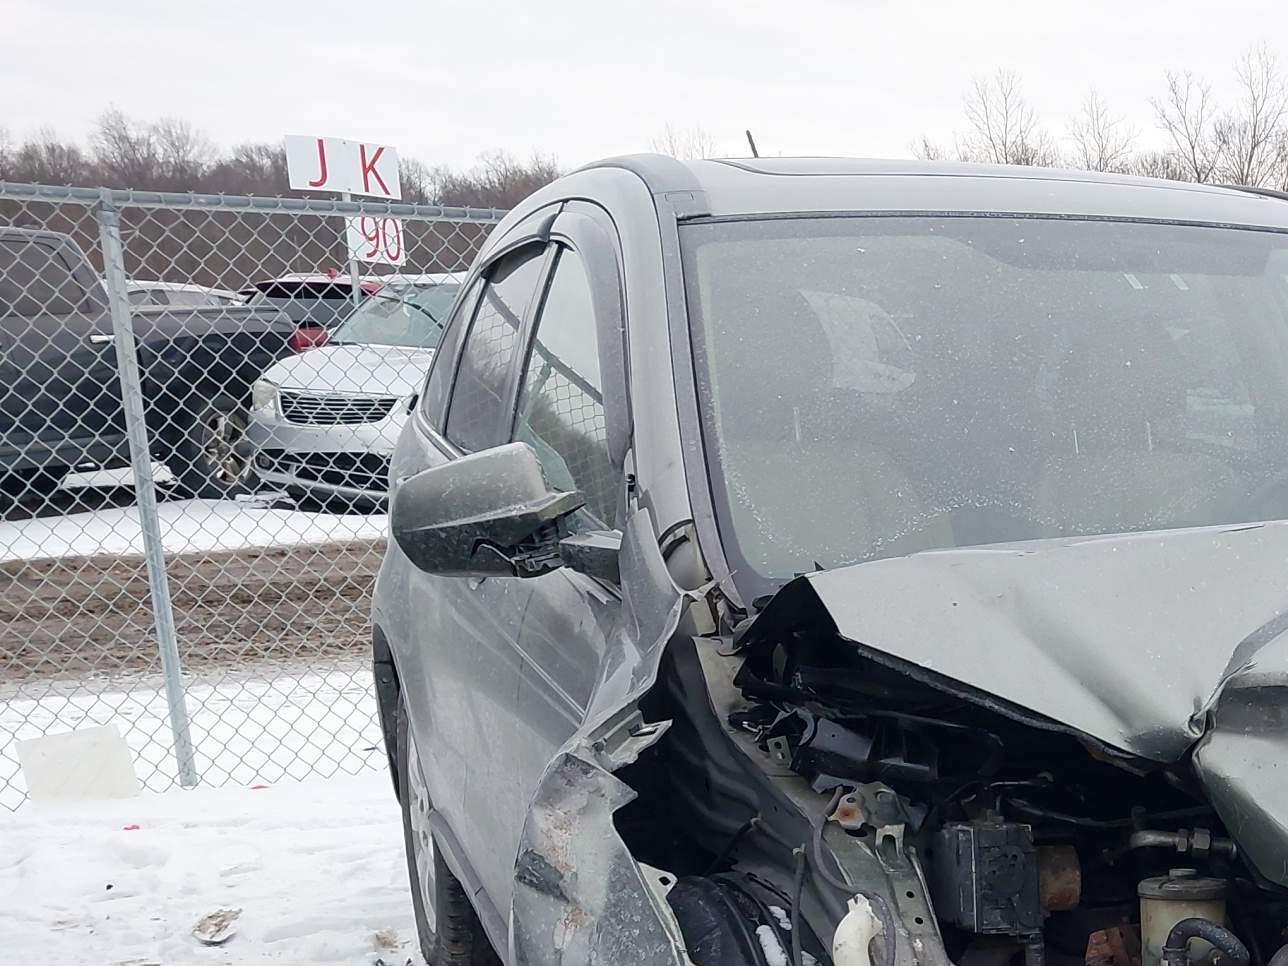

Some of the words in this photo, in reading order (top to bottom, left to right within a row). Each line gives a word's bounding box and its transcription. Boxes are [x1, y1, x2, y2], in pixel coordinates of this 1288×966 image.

[308, 138, 329, 188] J
[359, 143, 391, 196] K
[360, 216, 402, 262] 90
